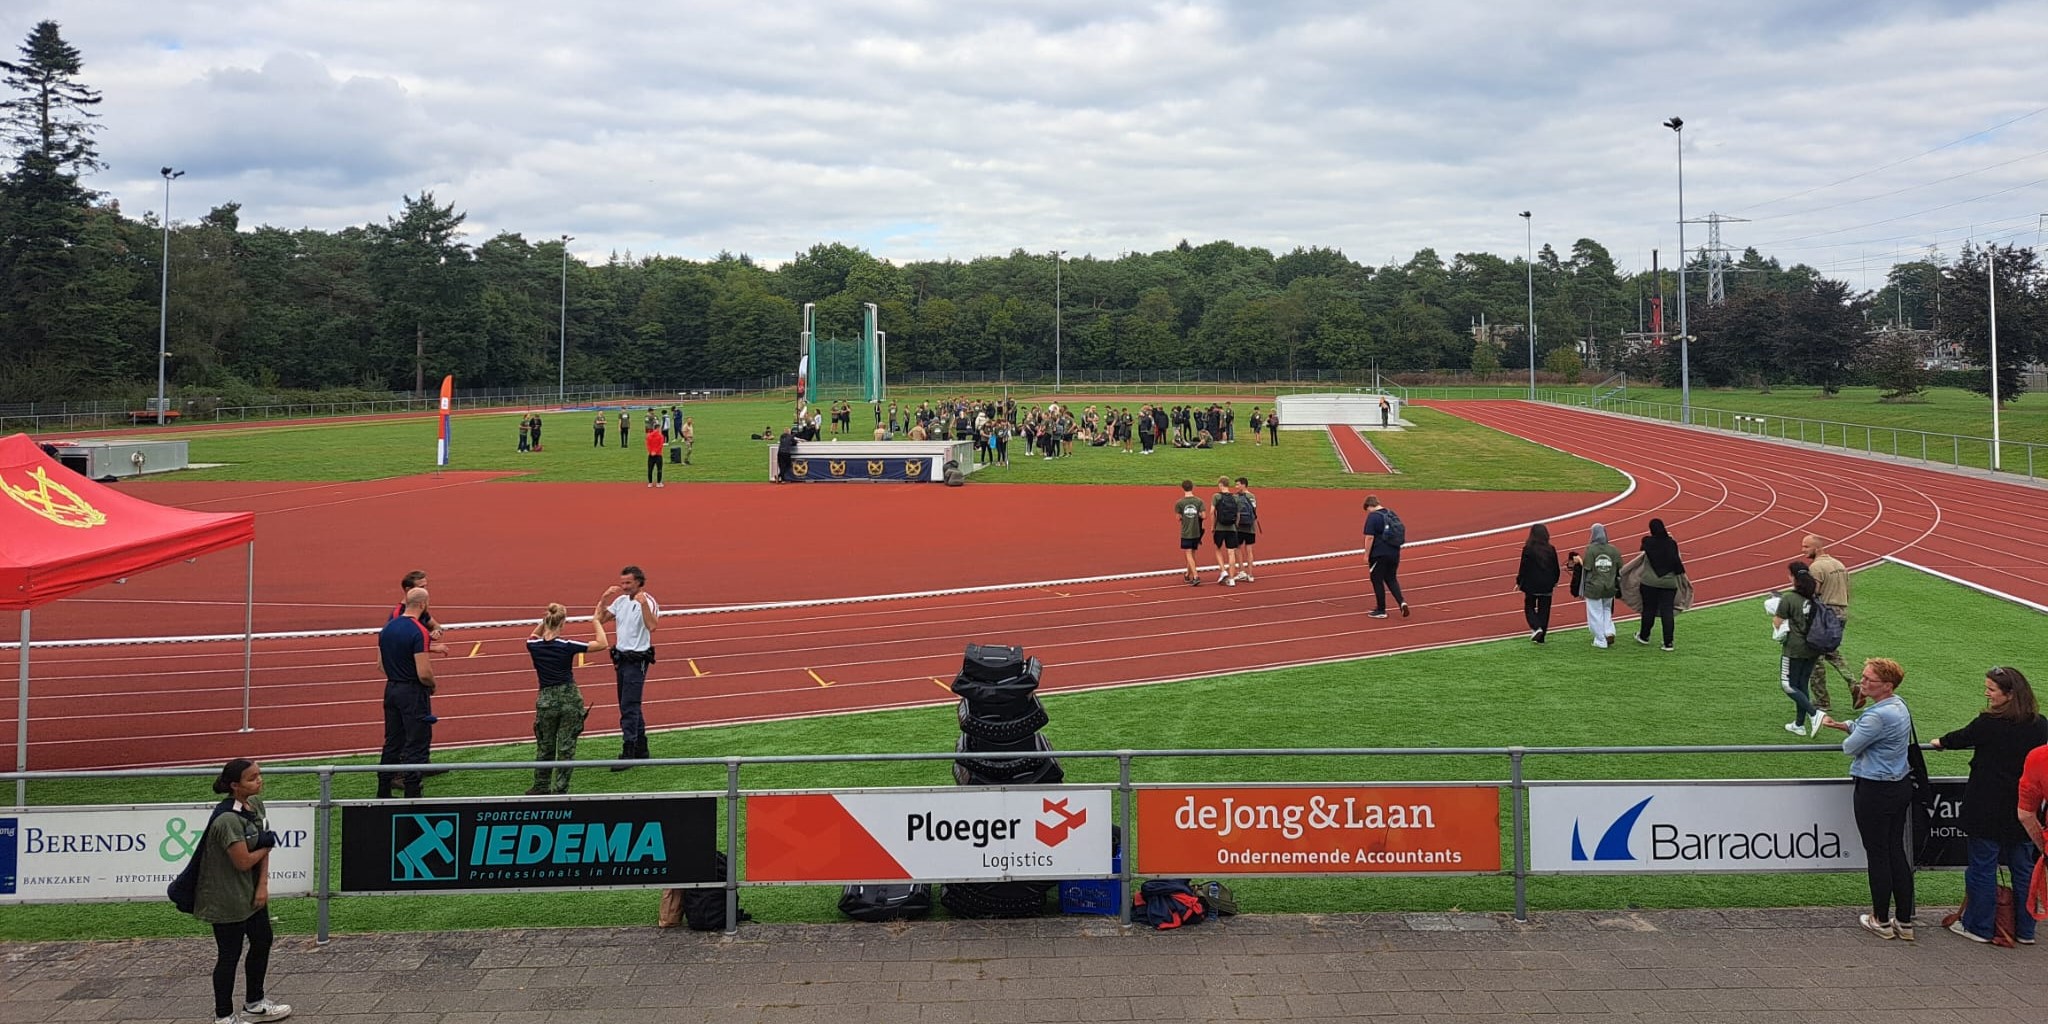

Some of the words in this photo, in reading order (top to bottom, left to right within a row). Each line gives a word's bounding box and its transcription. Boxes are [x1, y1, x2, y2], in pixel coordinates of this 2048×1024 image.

[475, 810, 573, 822] SPORTCENTRUM
[907, 811, 1021, 848] Ploeger
[24, 827, 147, 853] BERENDS
[470, 822, 667, 866] IEDEMA
[983, 851, 1053, 871] Logistics
[1217, 849, 1350, 864] Ondernemende
[1355, 849, 1462, 864] Accountants
[23, 875, 91, 885] BANKZAKEN
[470, 868, 581, 880] Professionals
[590, 868, 603, 877] in
[612, 866, 668, 876] fitness
